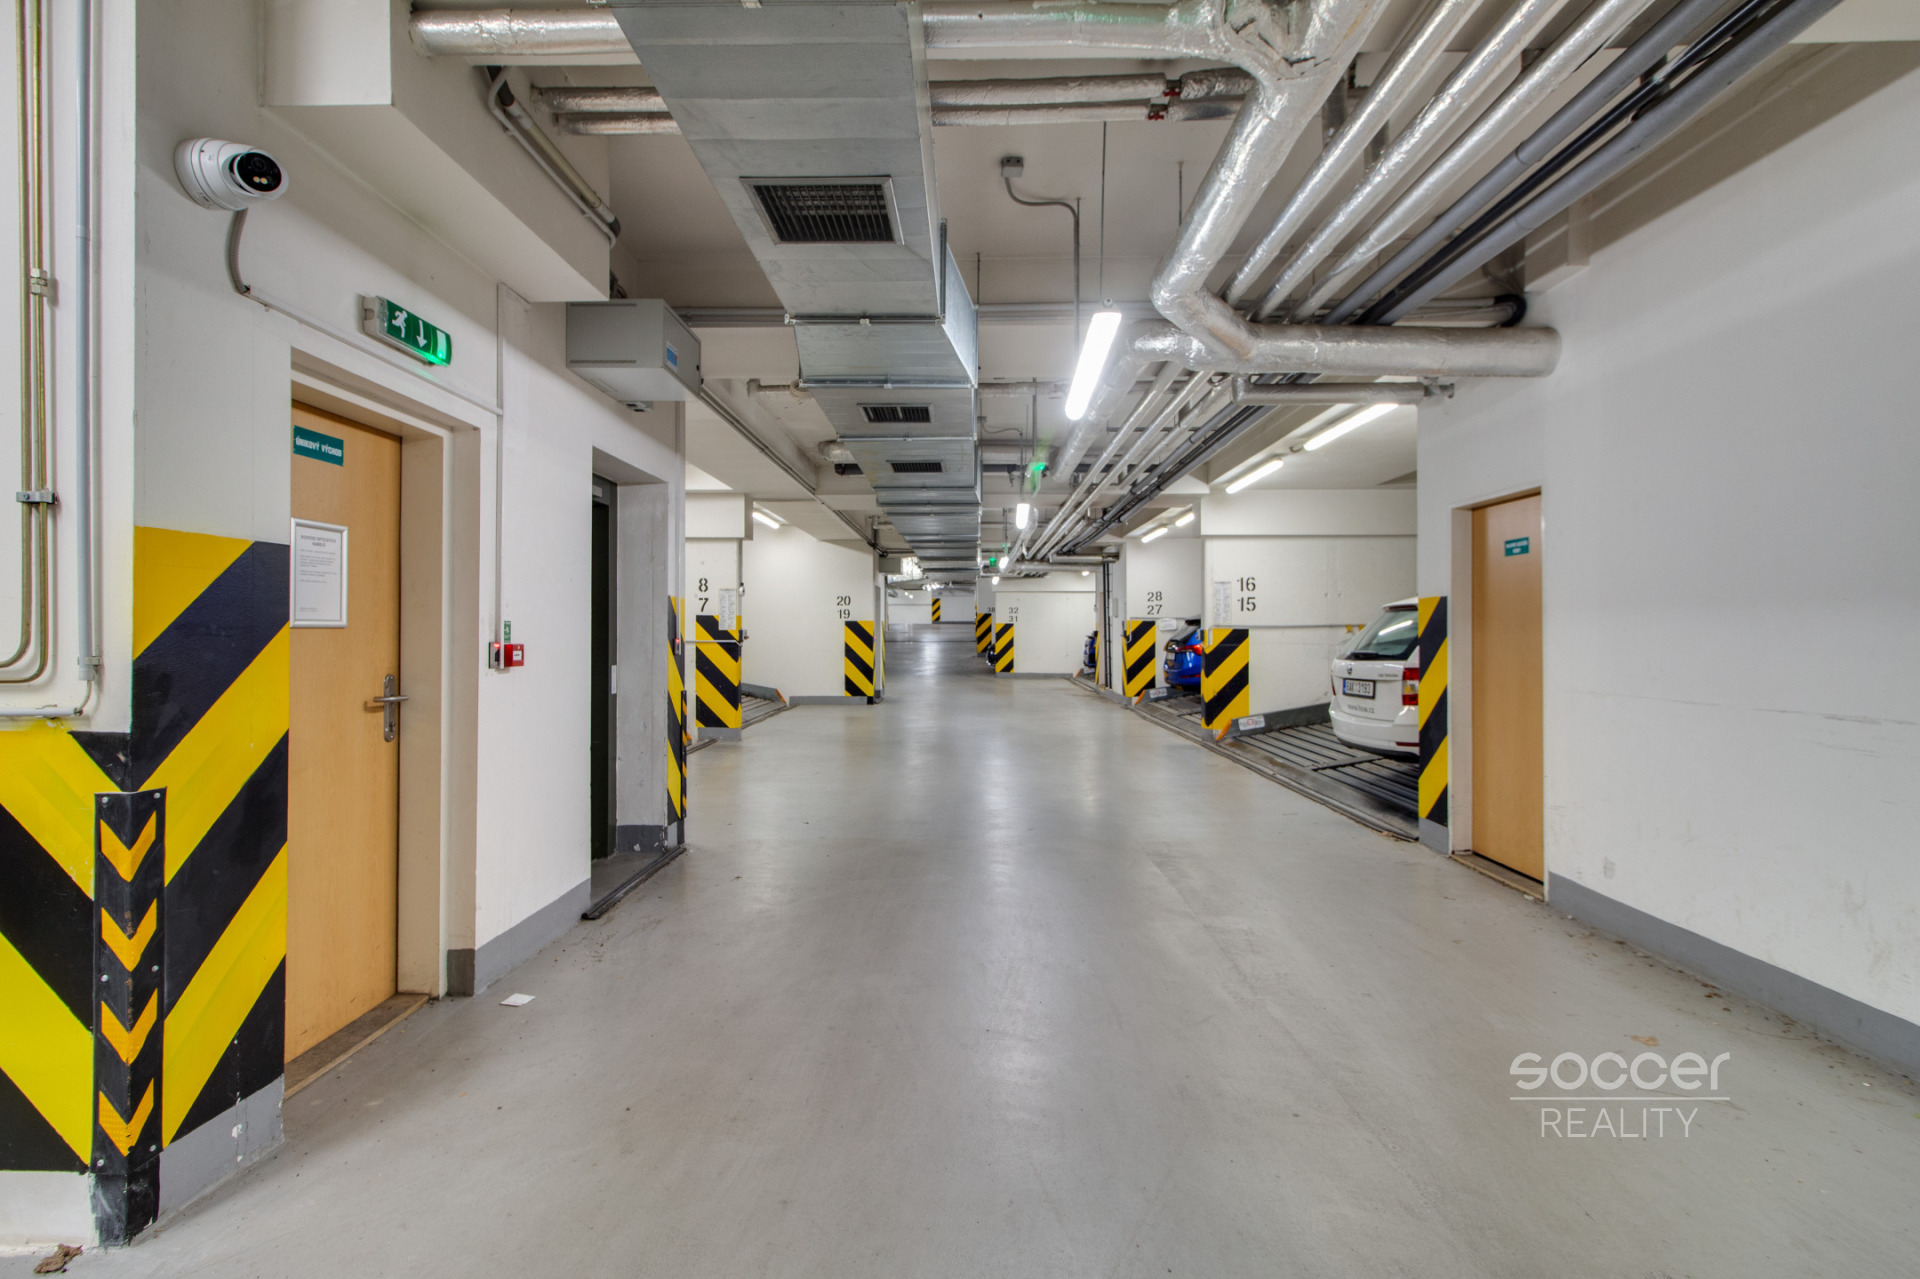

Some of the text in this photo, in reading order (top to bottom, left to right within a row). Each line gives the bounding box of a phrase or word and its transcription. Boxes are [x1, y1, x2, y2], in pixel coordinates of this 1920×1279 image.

[296, 435, 342, 457] ÚNIKOVÝ VÝCHOD
[698, 577, 709, 593] 8
[1236, 577, 1256, 592] 16
[836, 595, 851, 606] 20
[1147, 591, 1163, 602] 28
[698, 597, 709, 613] 7
[1008, 606, 1019, 615] 32
[1147, 604, 1163, 615] 27
[1236, 597, 1256, 612] 15
[837, 608, 851, 620] 19
[1008, 615, 1018, 623] 31
